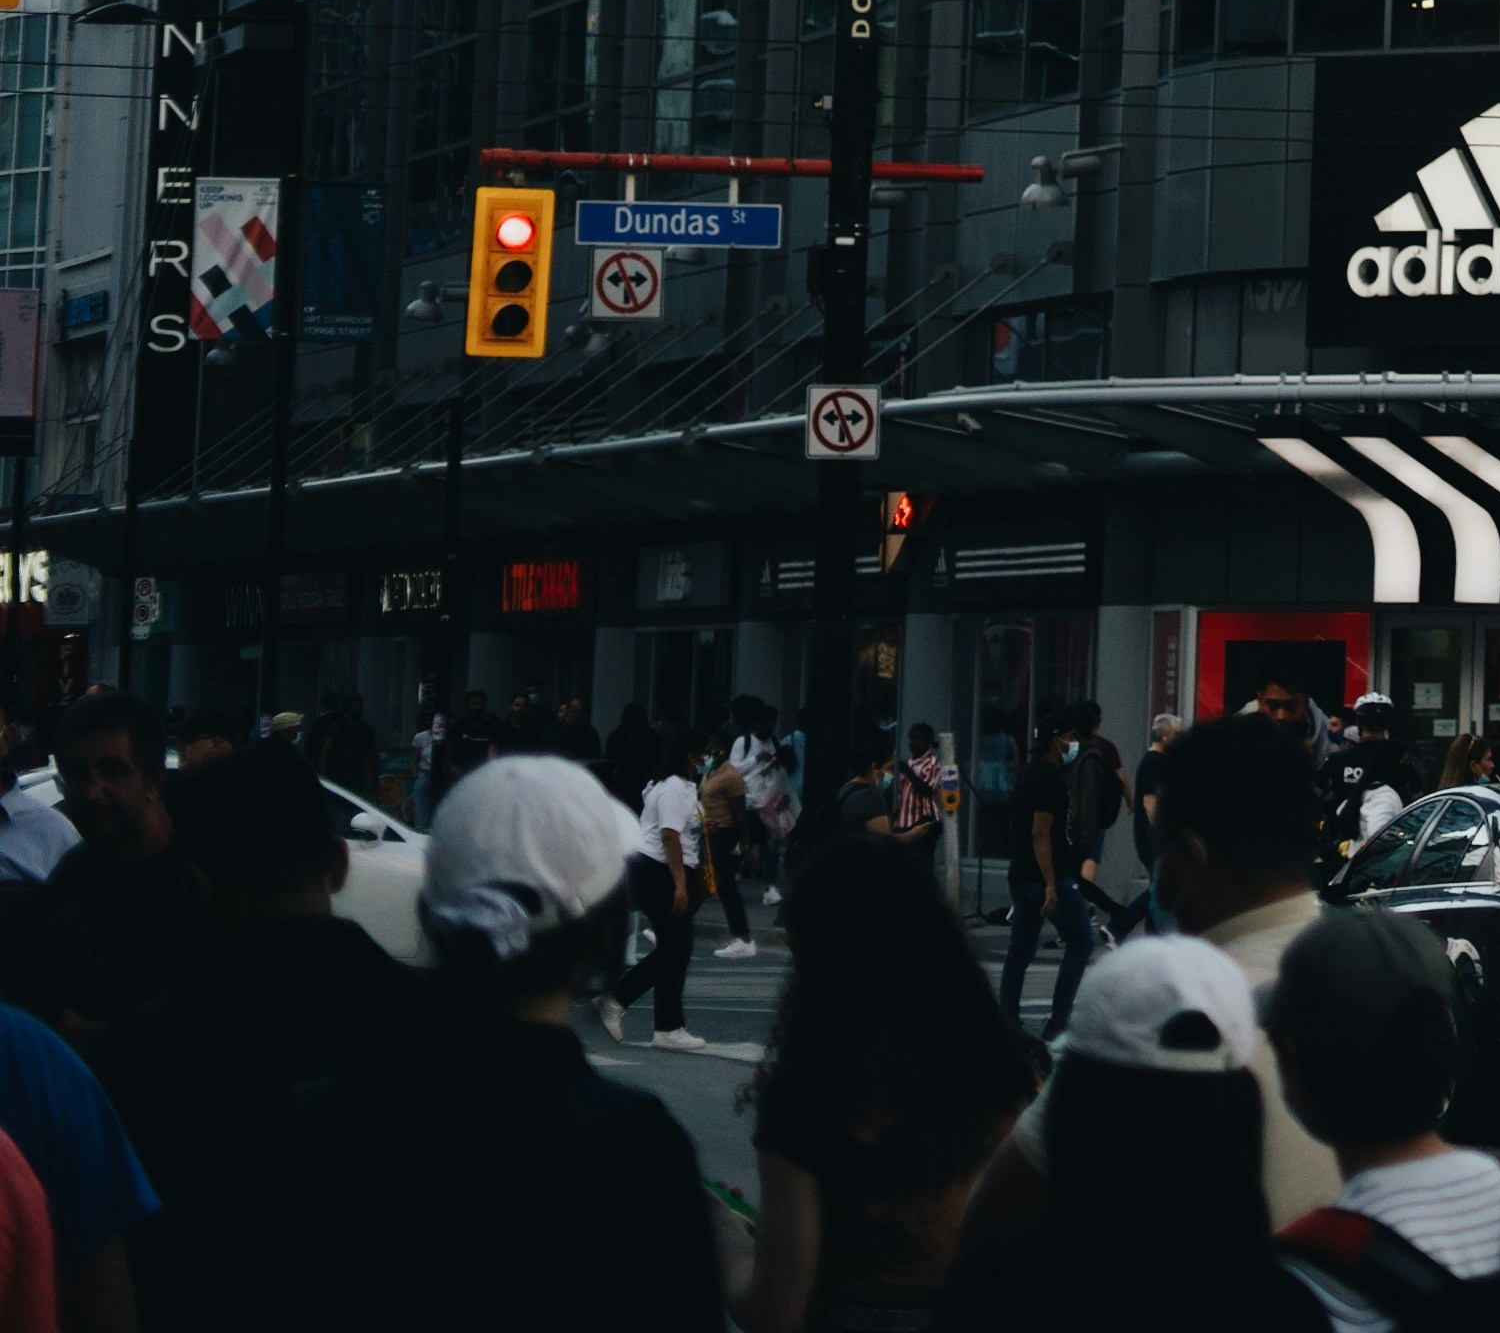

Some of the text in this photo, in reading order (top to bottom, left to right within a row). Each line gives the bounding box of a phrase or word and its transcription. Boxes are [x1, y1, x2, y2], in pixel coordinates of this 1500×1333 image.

[199, 186, 224, 194] KEEP
[199, 194, 244, 203] LOOKING
[199, 202, 214, 210] UP
[613, 206, 748, 237] Dundas St
[303, 316, 374, 324] ART CORRIDOR
